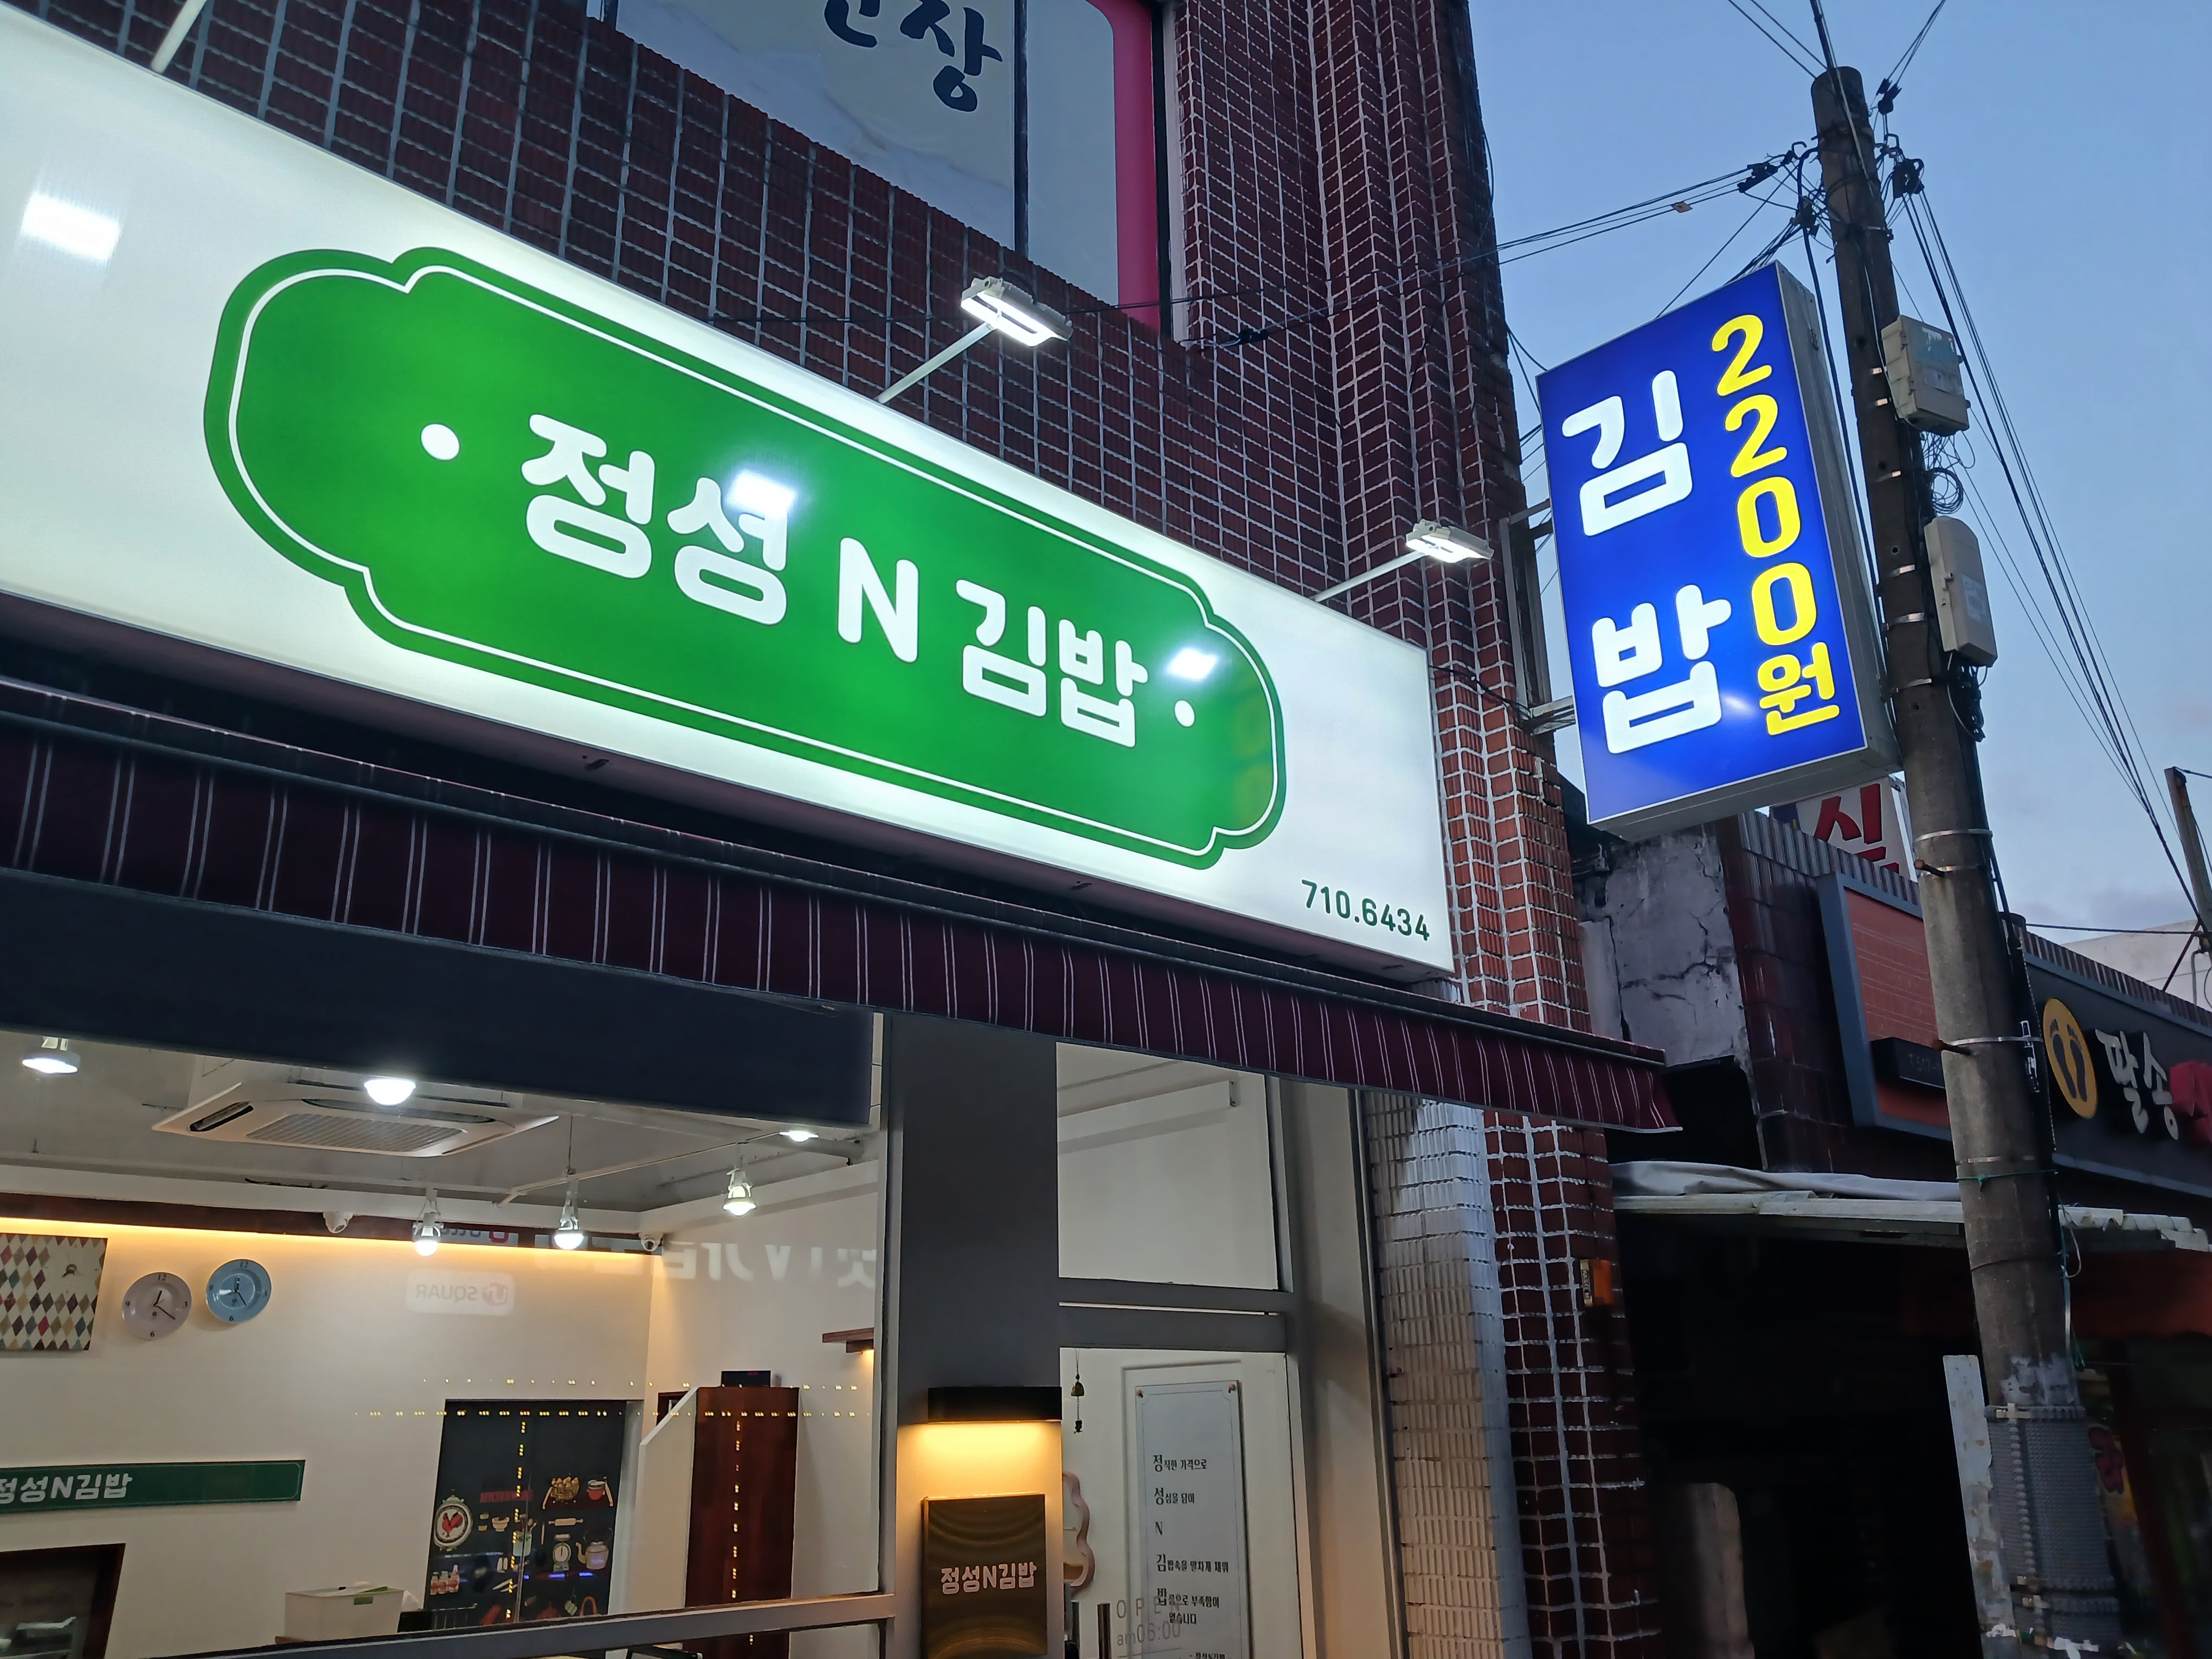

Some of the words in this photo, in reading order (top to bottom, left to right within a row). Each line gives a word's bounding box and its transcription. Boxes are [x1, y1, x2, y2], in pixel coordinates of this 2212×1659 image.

[1711, 314, 1840, 736] 2200원
[521, 414, 788, 625] 정성
[838, 537, 919, 663] N
[955, 579, 1148, 748] 김밥
[1562, 369, 1732, 754] 김밥
[1301, 879, 1430, 941] 710.6434
[1180, 1458, 1207, 1470] 가격으로
[0, 1473, 133, 1504] 정성N김밥
[1155, 1521, 1163, 1535] N
[941, 1561, 1037, 1595] 정성N김밥
